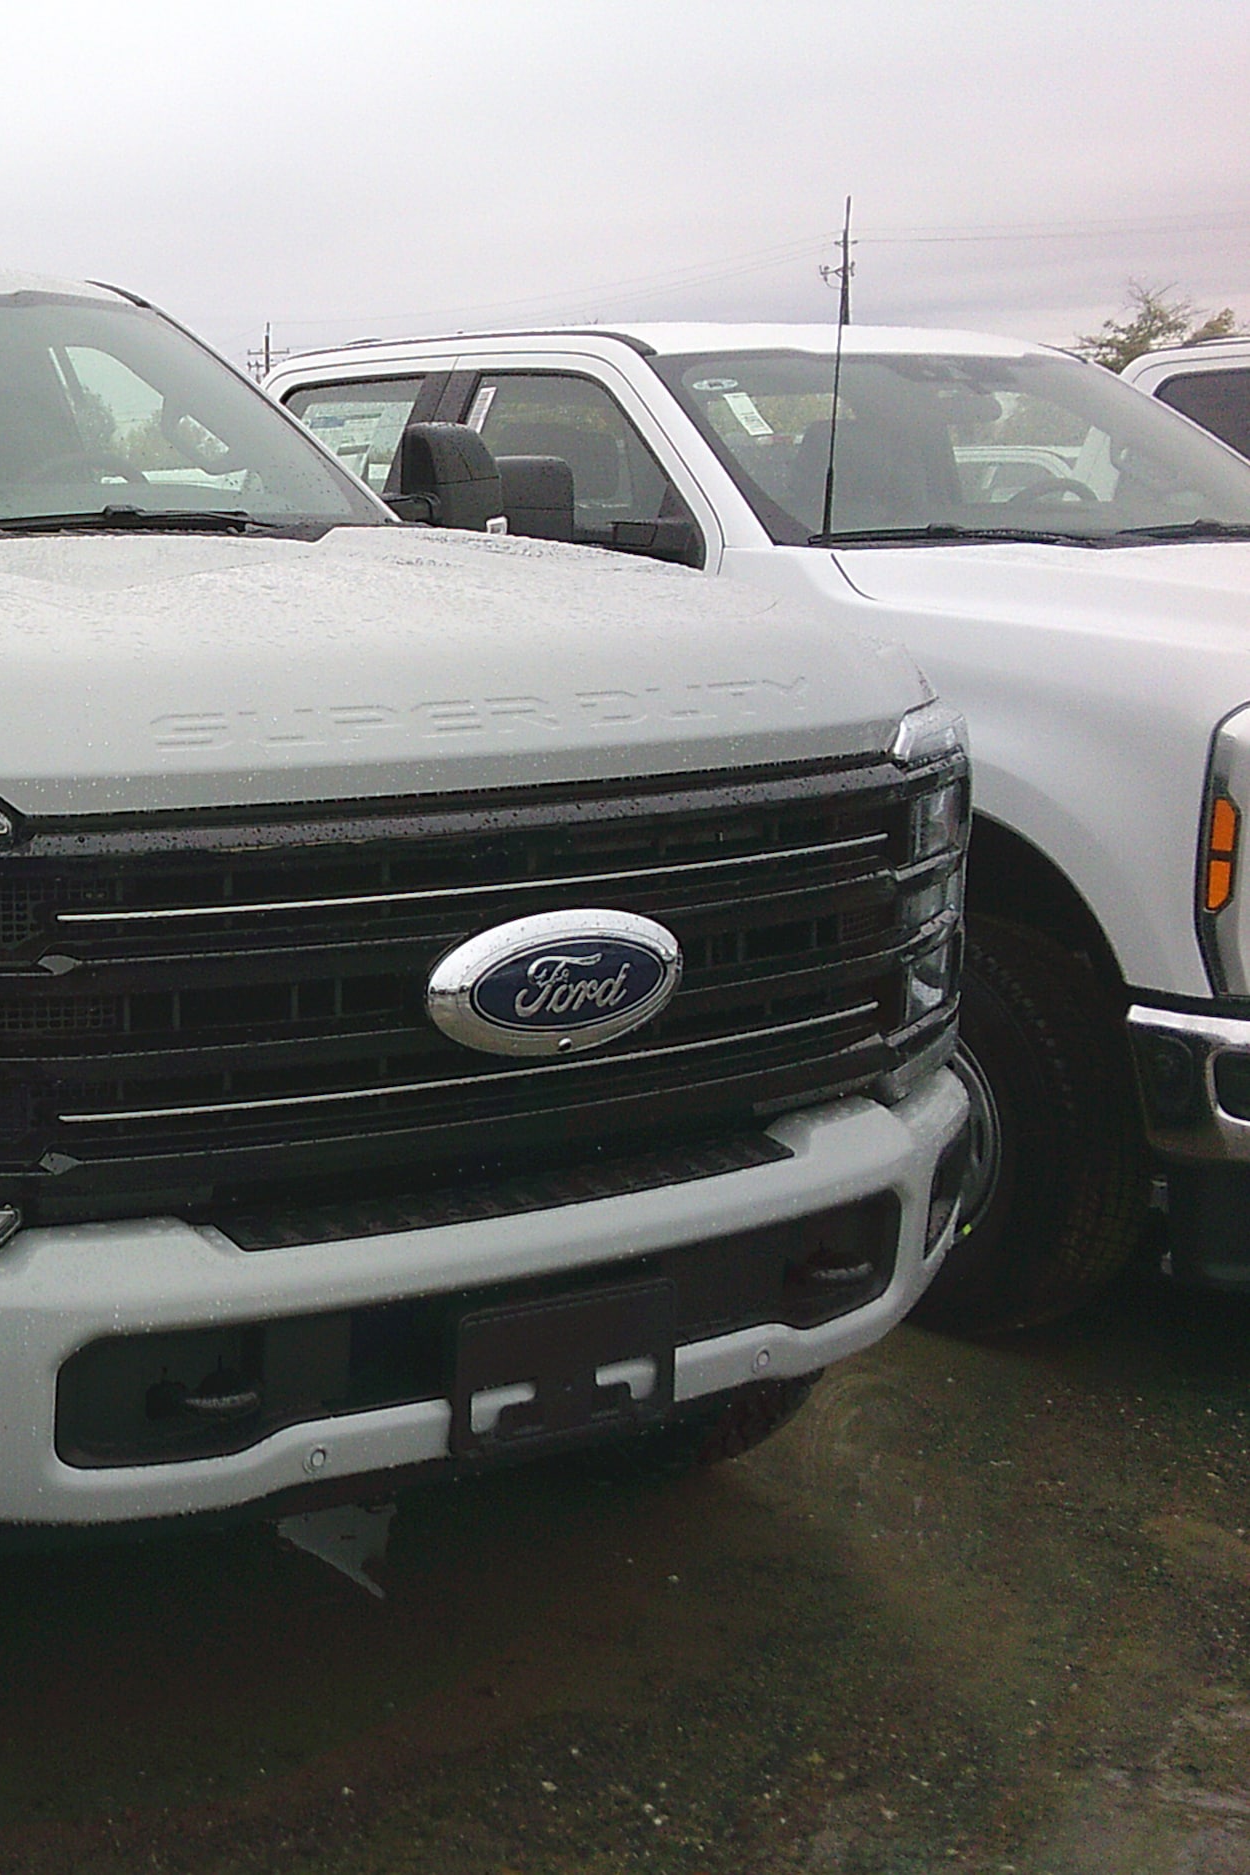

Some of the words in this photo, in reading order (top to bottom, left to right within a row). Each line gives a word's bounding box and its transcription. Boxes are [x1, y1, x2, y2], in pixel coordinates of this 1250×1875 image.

[149, 695, 561, 753] SUPER
[575, 676, 806, 728] DUTY
[514, 952, 631, 1018] Ford
